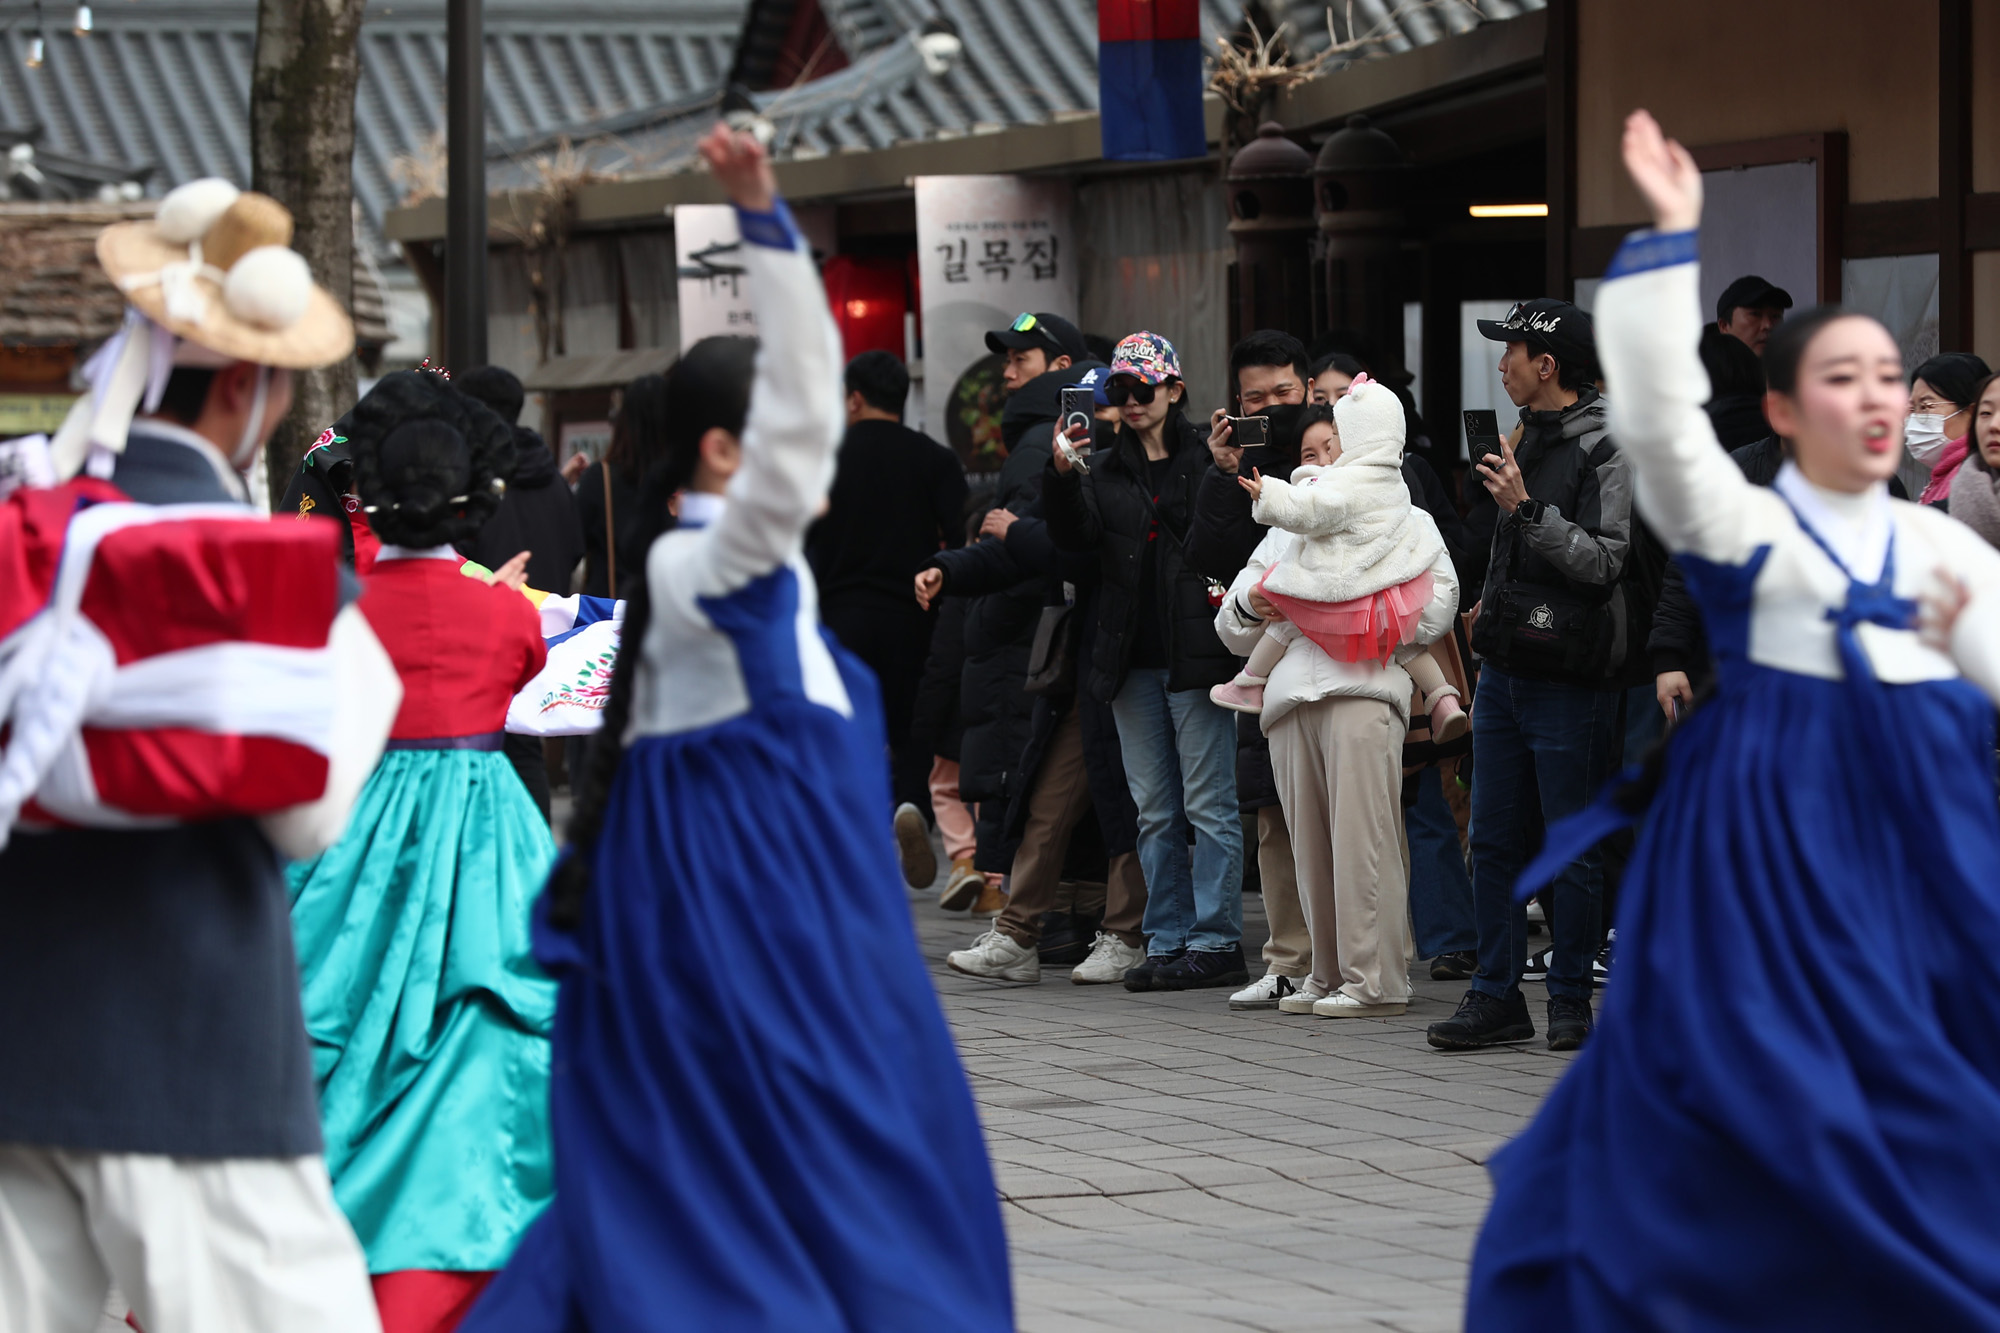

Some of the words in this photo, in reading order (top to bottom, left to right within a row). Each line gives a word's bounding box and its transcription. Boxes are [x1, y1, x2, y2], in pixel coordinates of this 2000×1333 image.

[936, 234, 1059, 283] 길목집
[1113, 344, 1134, 362] New
[1127, 342, 1157, 361] York
